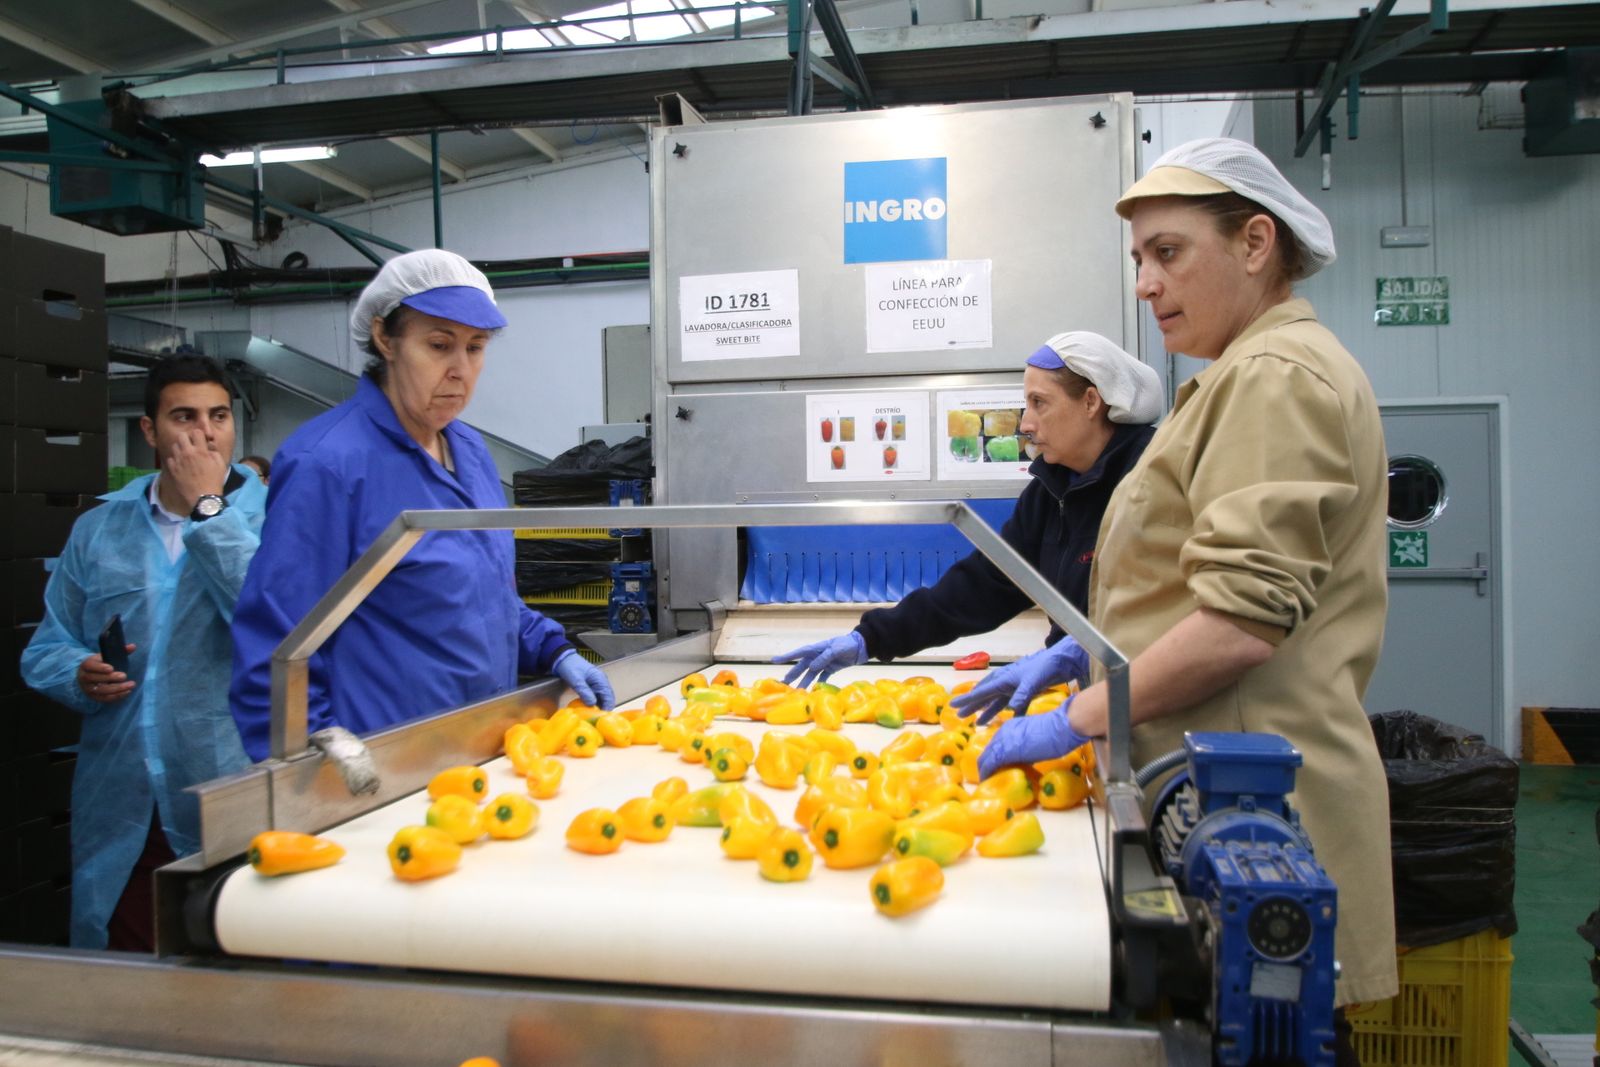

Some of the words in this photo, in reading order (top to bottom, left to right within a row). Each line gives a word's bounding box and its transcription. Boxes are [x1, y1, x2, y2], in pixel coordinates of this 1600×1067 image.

[845, 197, 946, 223] INGRO
[892, 277, 928, 291] LÍNEA
[1382, 281, 1444, 296] SALIDA
[705, 296, 723, 310] ID
[729, 292, 770, 309] 1781
[879, 295, 959, 311] CONFECCIÓN
[962, 296, 979, 306] DE
[1381, 304, 1445, 321] EXIT
[684, 319, 792, 332] LAVADORA/CLASIFICADORA
[912, 318, 946, 330] EEUU
[716, 336, 742, 345] SWEET
[744, 335, 761, 343] BITE
[875, 406, 901, 414] DESTRÍO
